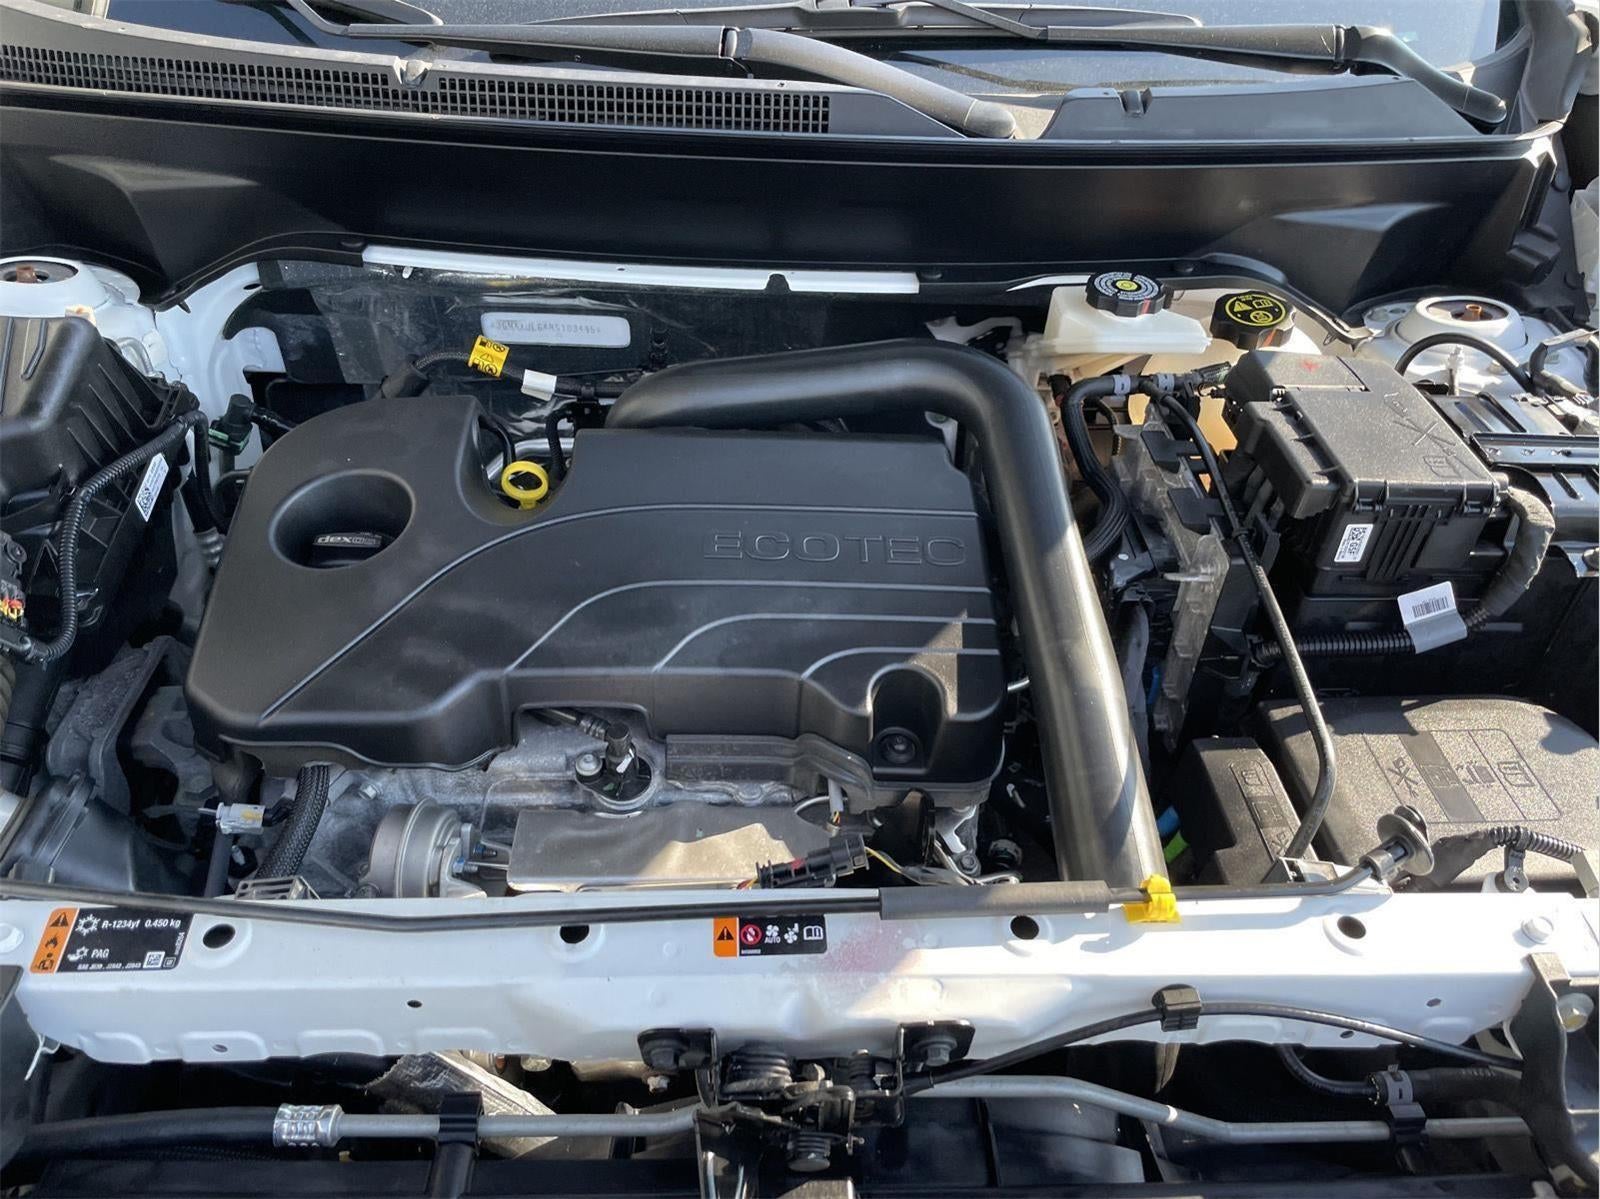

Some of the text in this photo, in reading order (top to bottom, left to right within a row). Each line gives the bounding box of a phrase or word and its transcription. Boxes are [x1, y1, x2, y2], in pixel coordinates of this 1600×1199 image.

[704, 530, 966, 566] ECOTEC
[101, 918, 181, 929] R-1234yf 0.450 kg
[764, 936, 781, 944] AUTO
[91, 948, 110, 958] PAG
